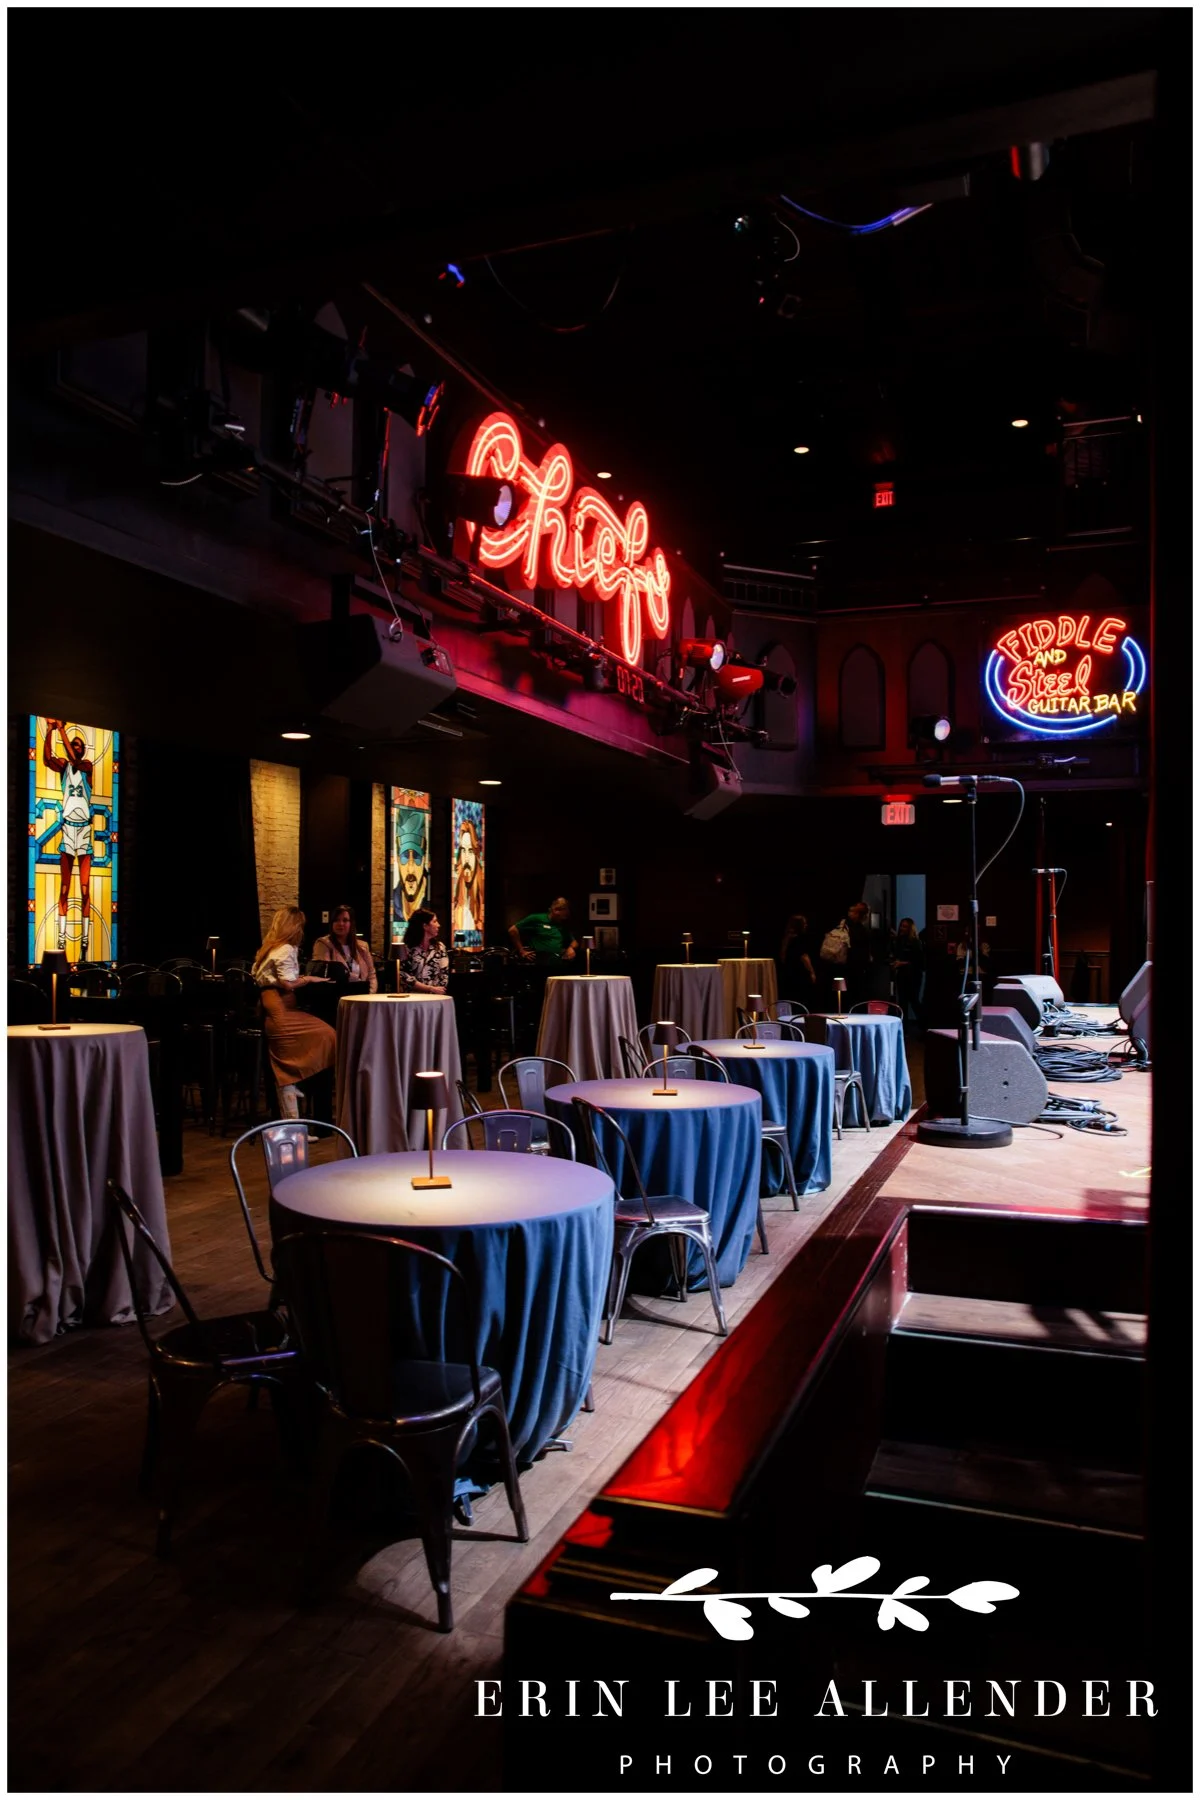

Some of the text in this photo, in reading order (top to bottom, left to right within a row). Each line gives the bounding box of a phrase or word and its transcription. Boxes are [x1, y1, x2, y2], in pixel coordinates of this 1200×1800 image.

[875, 491, 893, 507] EXIT
[996, 614, 1127, 664] FIDDLE
[1033, 648, 1067, 668] AND
[1028, 690, 1137, 716] GUITAR BAR
[68, 784, 84, 798] 23
[886, 804, 910, 825] EXIT
